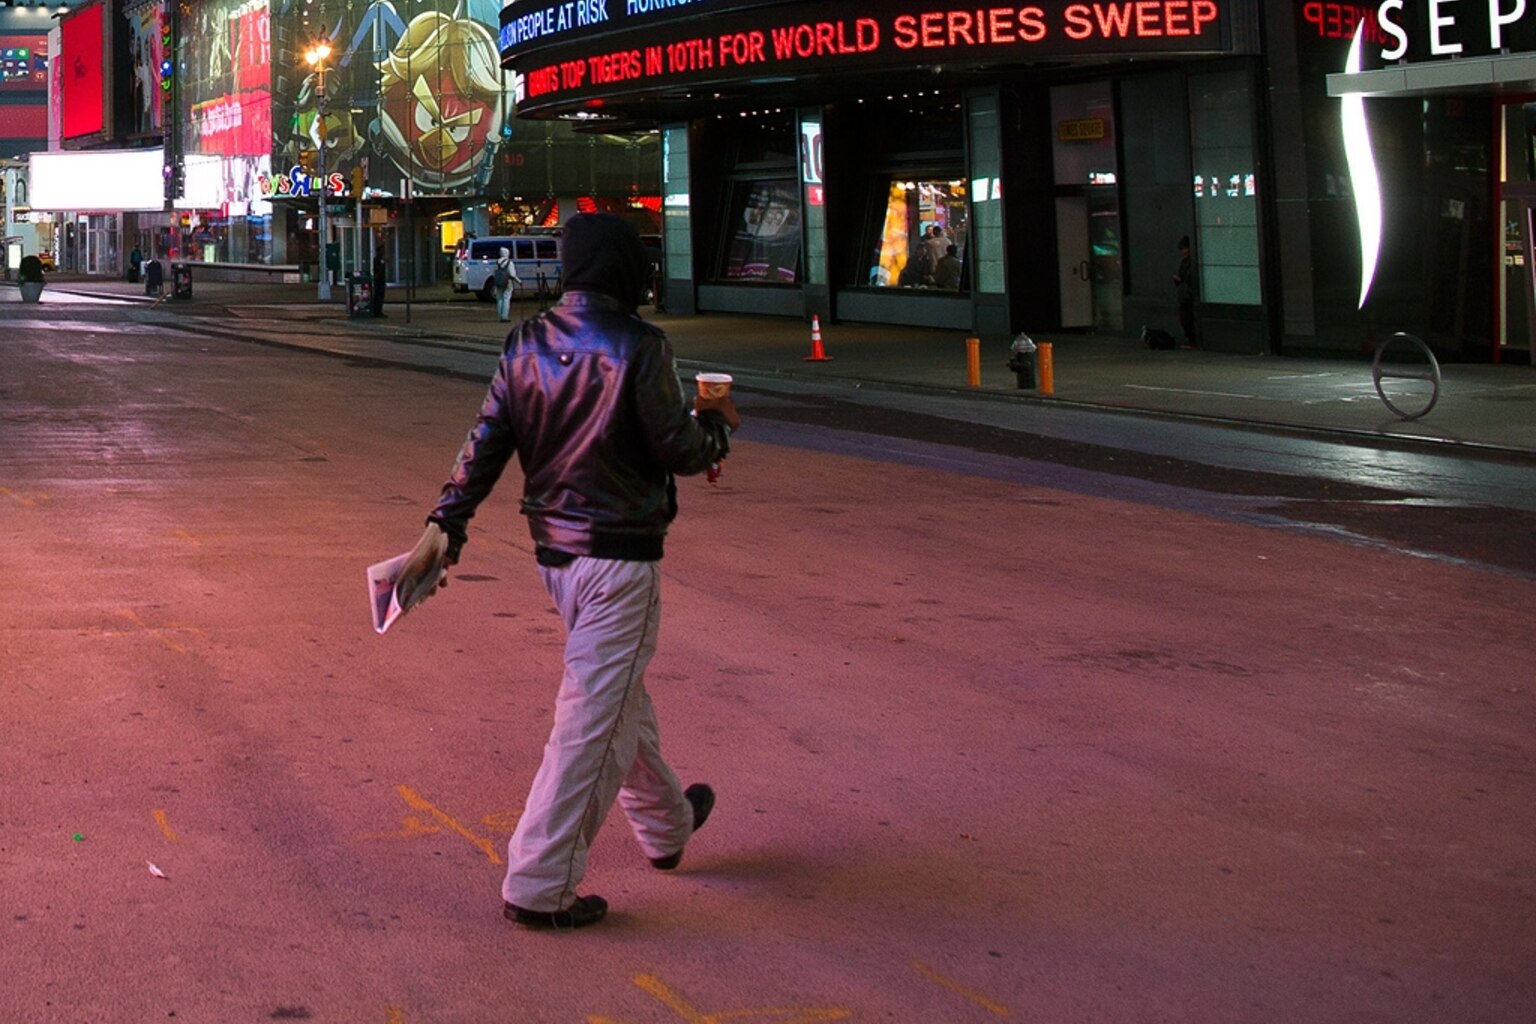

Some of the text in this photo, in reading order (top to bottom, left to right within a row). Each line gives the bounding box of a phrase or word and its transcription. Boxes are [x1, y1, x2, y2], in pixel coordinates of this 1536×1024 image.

[517, 7, 555, 43] PEOPLE
[557, 2, 575, 32] AT
[561, 60, 586, 91] TOP
[588, 49, 641, 84] TIGERS
[646, 45, 662, 76] IN
[666, 38, 713, 73] 10TH
[719, 30, 765, 67] FOR
[772, 17, 880, 60] WORLD
[894, 6, 1047, 50] SERIES
[1063, 0, 1218, 40] SWEEP
